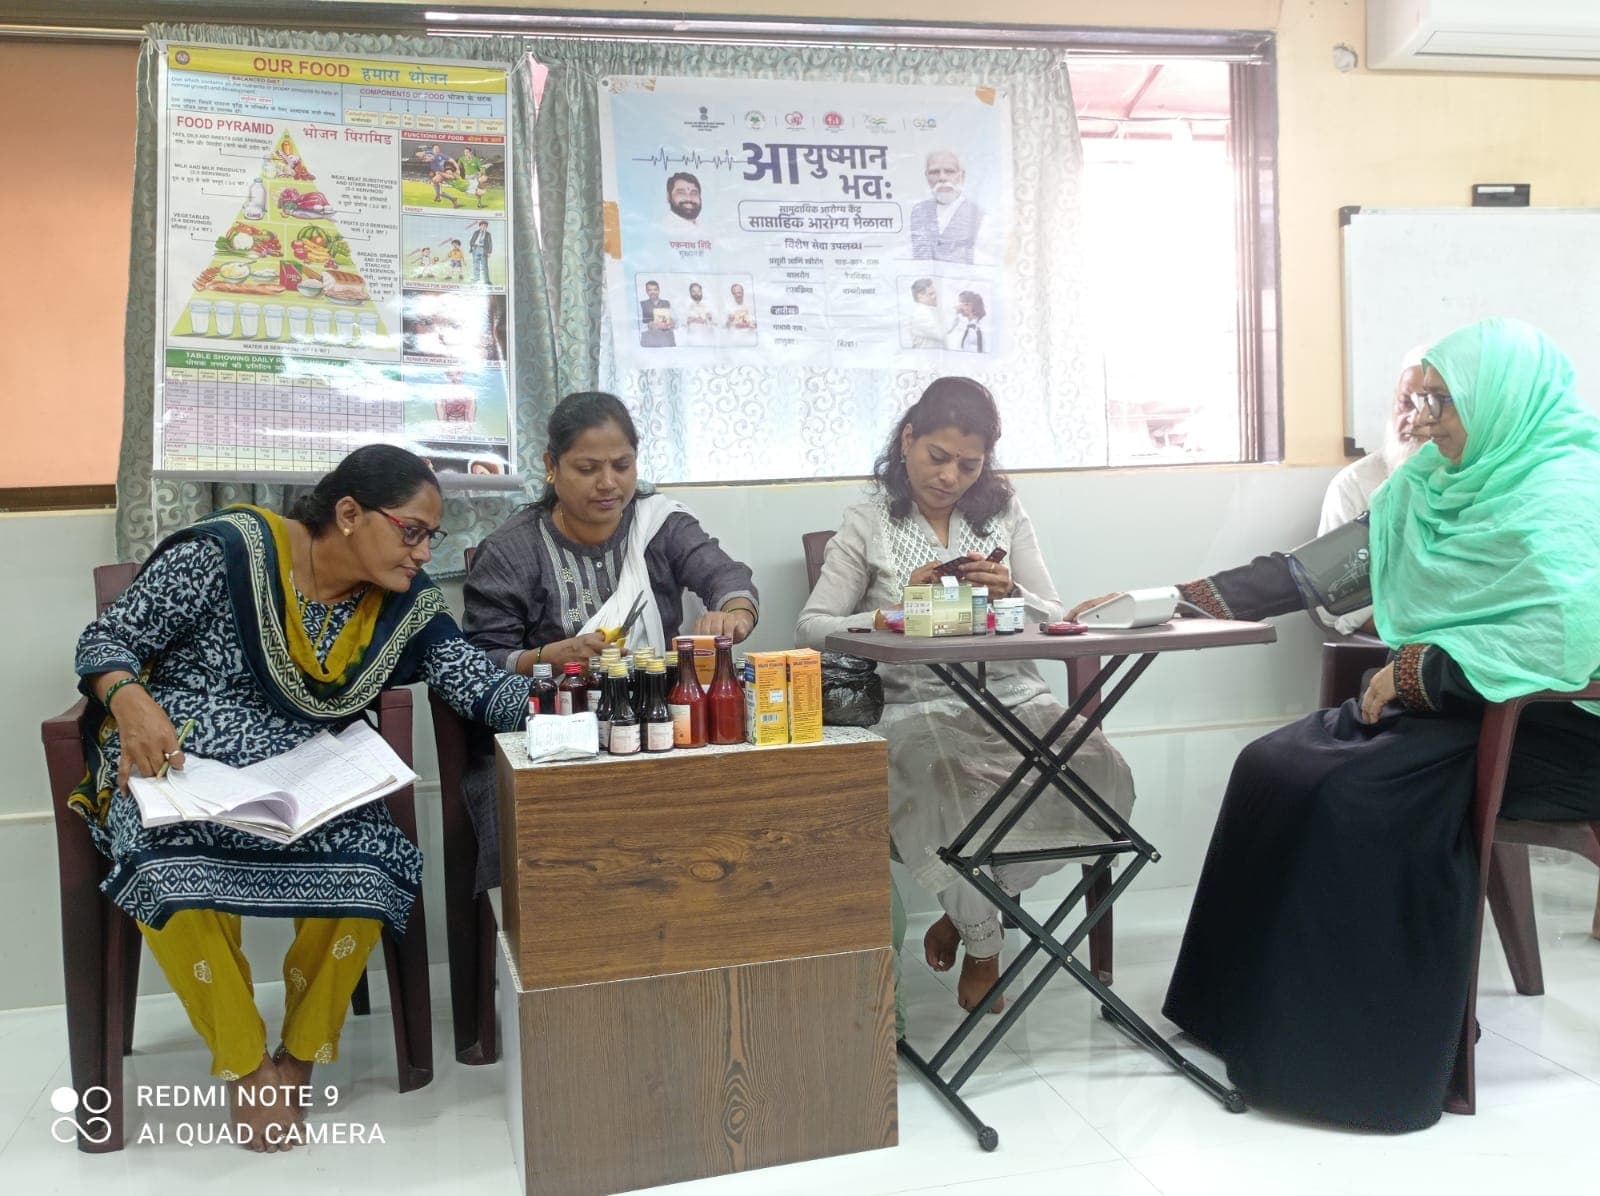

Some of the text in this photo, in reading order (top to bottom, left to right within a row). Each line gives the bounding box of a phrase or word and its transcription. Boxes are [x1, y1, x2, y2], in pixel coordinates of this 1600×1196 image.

[253, 57, 350, 78] OUR FOOD
[361, 67, 401, 82] हमारा
[360, 88, 411, 98] COMPONENTS
[176, 115, 274, 135] FOOD PYRAMID
[303, 124, 392, 144] भोजन पिरामिड
[404, 131, 437, 139] FUNCTIONS
[742, 142, 889, 185] आयुष्मान
[748, 213, 893, 230] साप्ताहिक आरोग्य मेळावा
[784, 238, 809, 250] विशेष
[811, 239, 828, 251] सेवा
[185, 351, 274, 364] TABLE SHOWING DAILY
